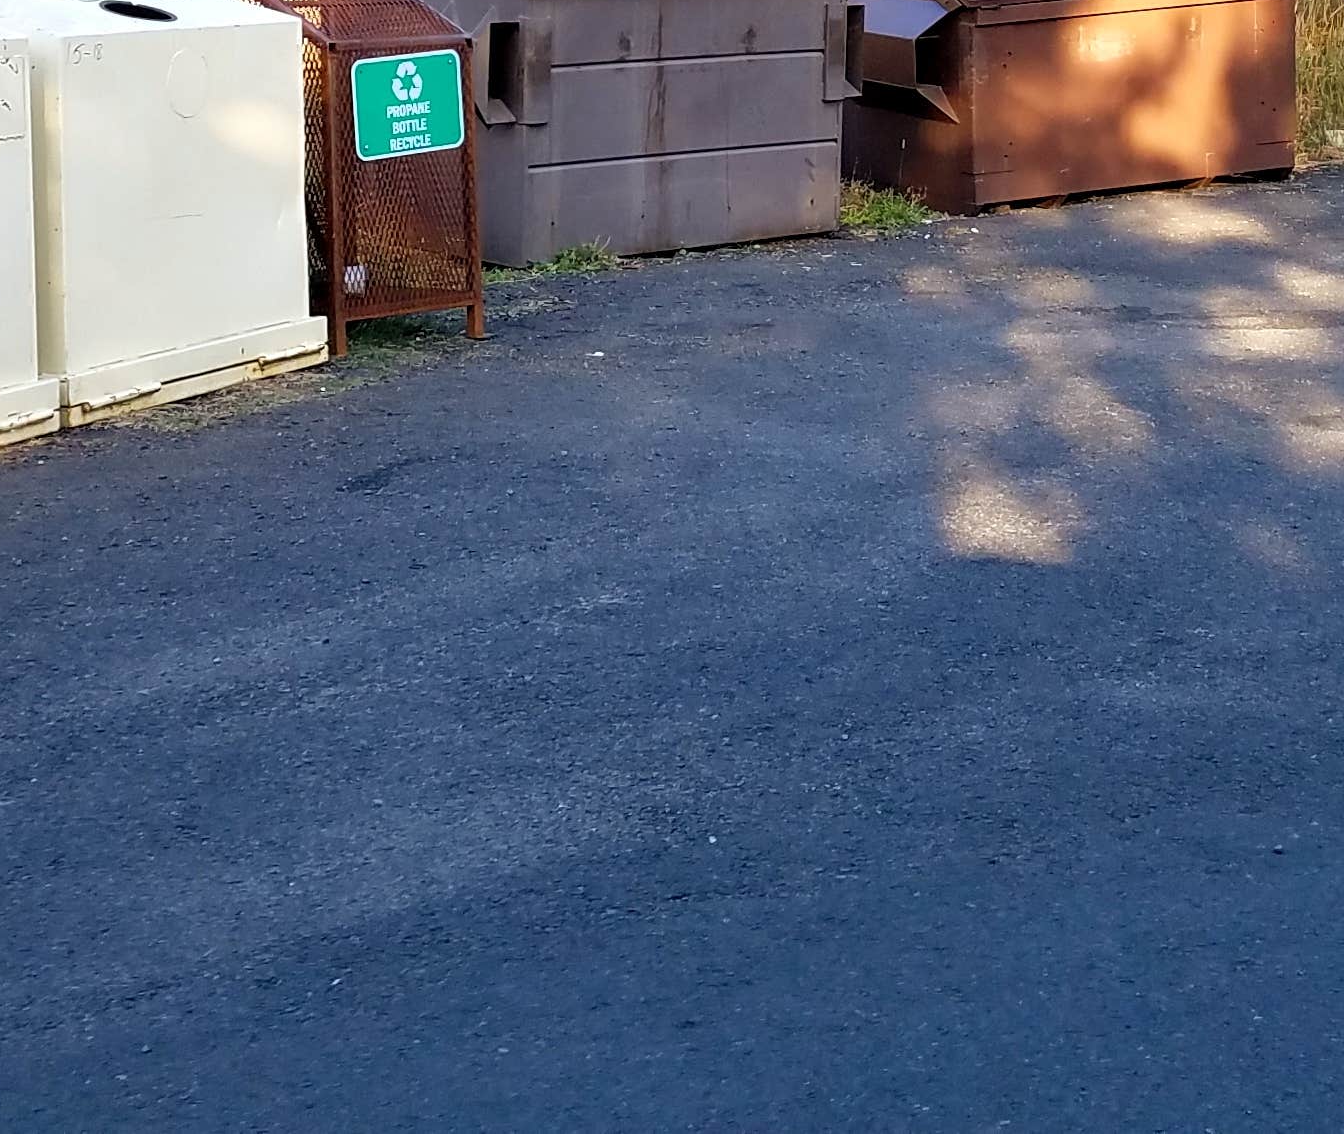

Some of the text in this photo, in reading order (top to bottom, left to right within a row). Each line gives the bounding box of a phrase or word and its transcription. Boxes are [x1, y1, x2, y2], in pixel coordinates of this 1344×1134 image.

[64, 41, 104, 66] 15-18
[386, 101, 431, 118] PROPANE
[392, 118, 428, 134] BOTTLE
[389, 134, 432, 151] RECYCLE
